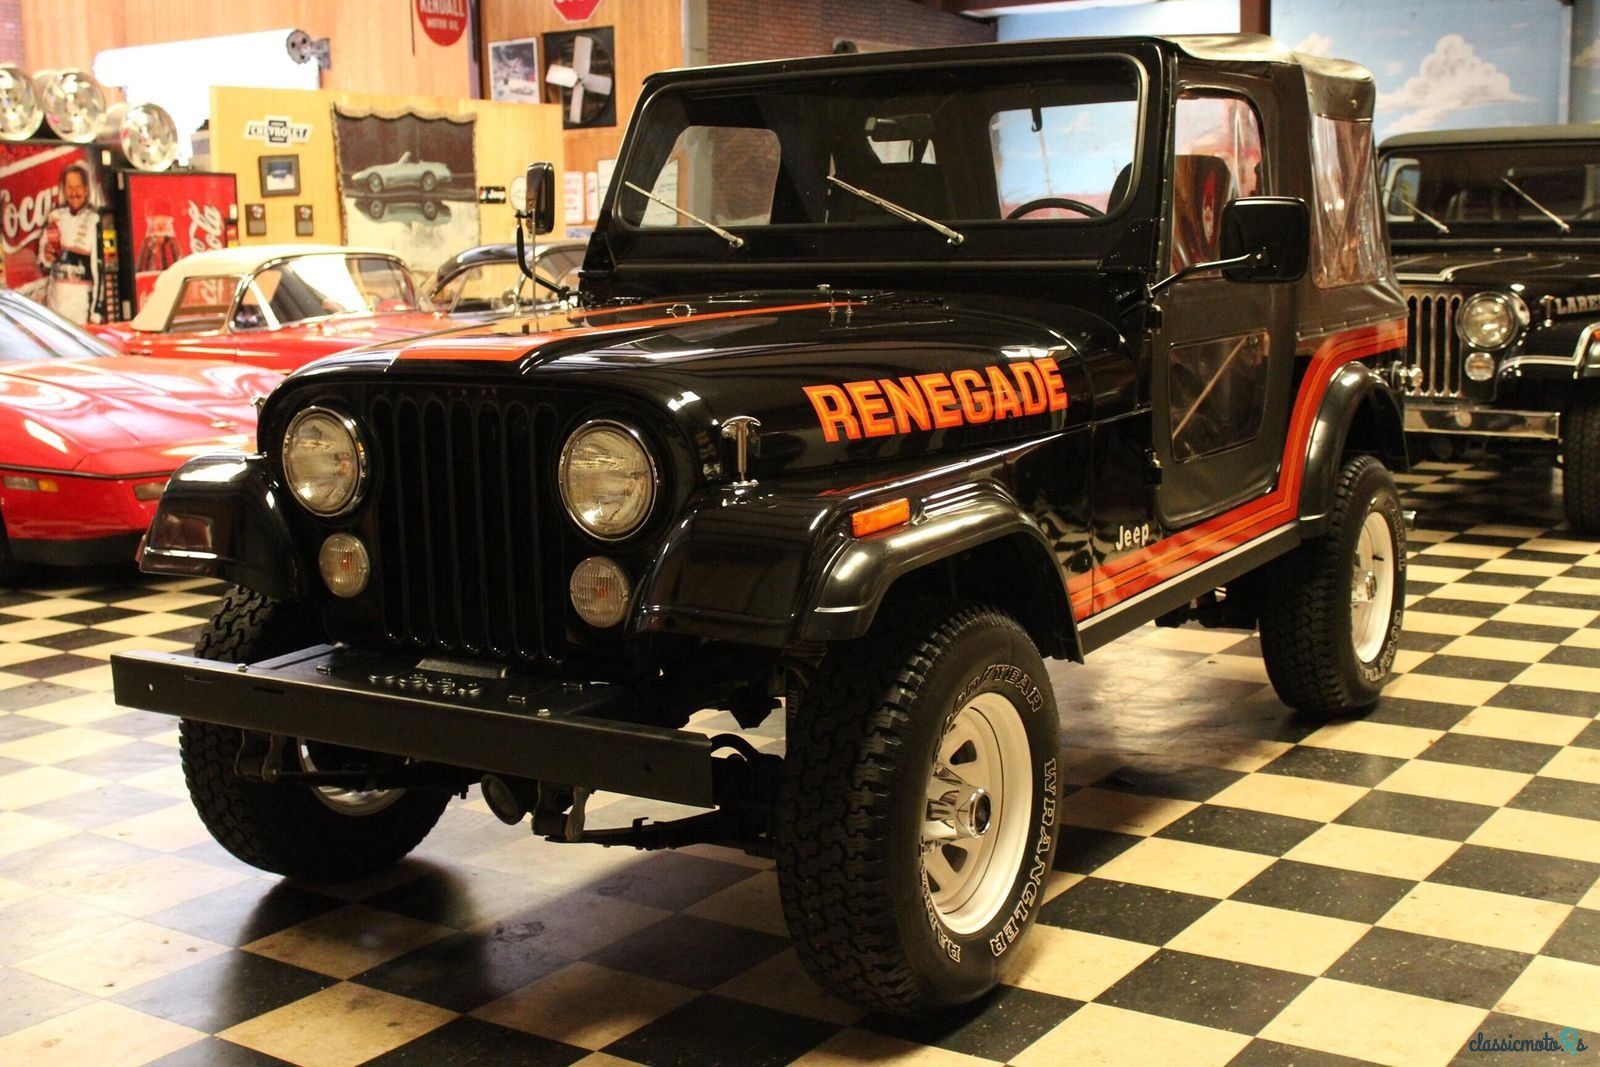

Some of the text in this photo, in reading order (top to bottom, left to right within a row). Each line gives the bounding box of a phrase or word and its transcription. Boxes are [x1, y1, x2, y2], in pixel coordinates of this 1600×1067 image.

[802, 357, 1068, 443] RENEGADE
[1115, 523, 1150, 551] Jeep
[990, 757, 1058, 958] WRANGLER
